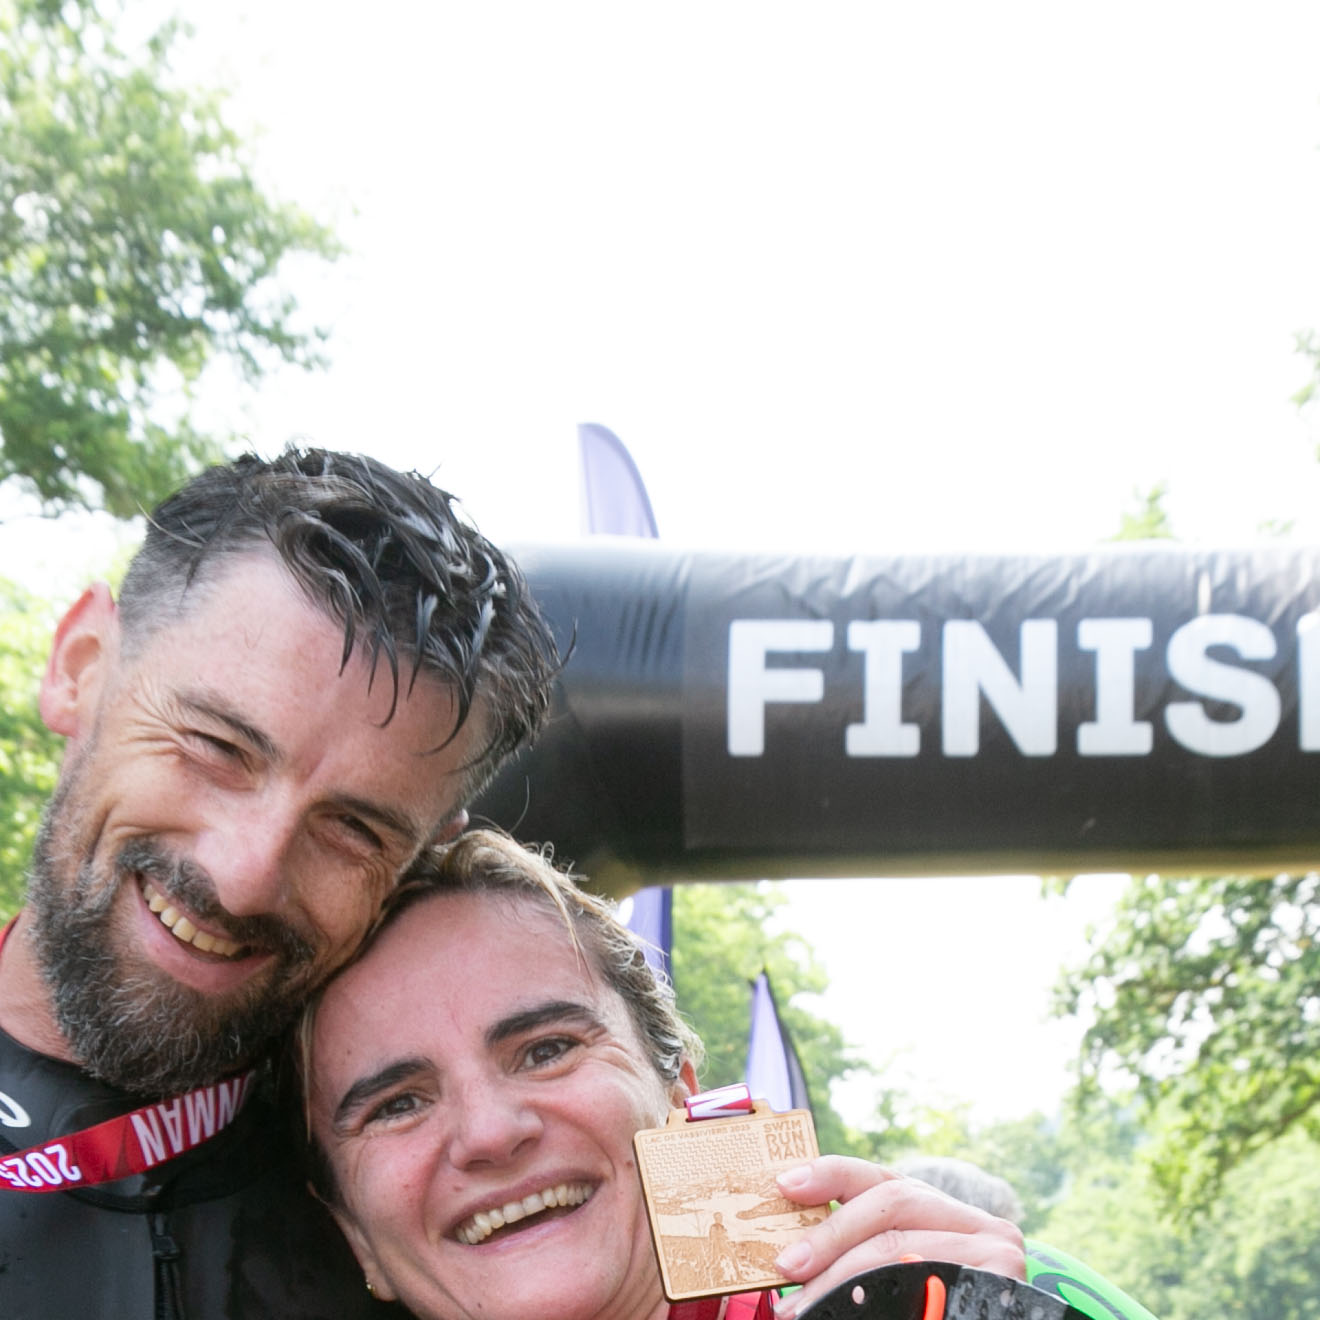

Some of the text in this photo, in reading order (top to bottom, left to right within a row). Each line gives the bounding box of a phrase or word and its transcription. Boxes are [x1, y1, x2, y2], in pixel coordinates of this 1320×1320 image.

[763, 1119, 802, 1133] SWIM
[765, 1132, 803, 1145] RUN
[769, 1144, 808, 1161] MAN
